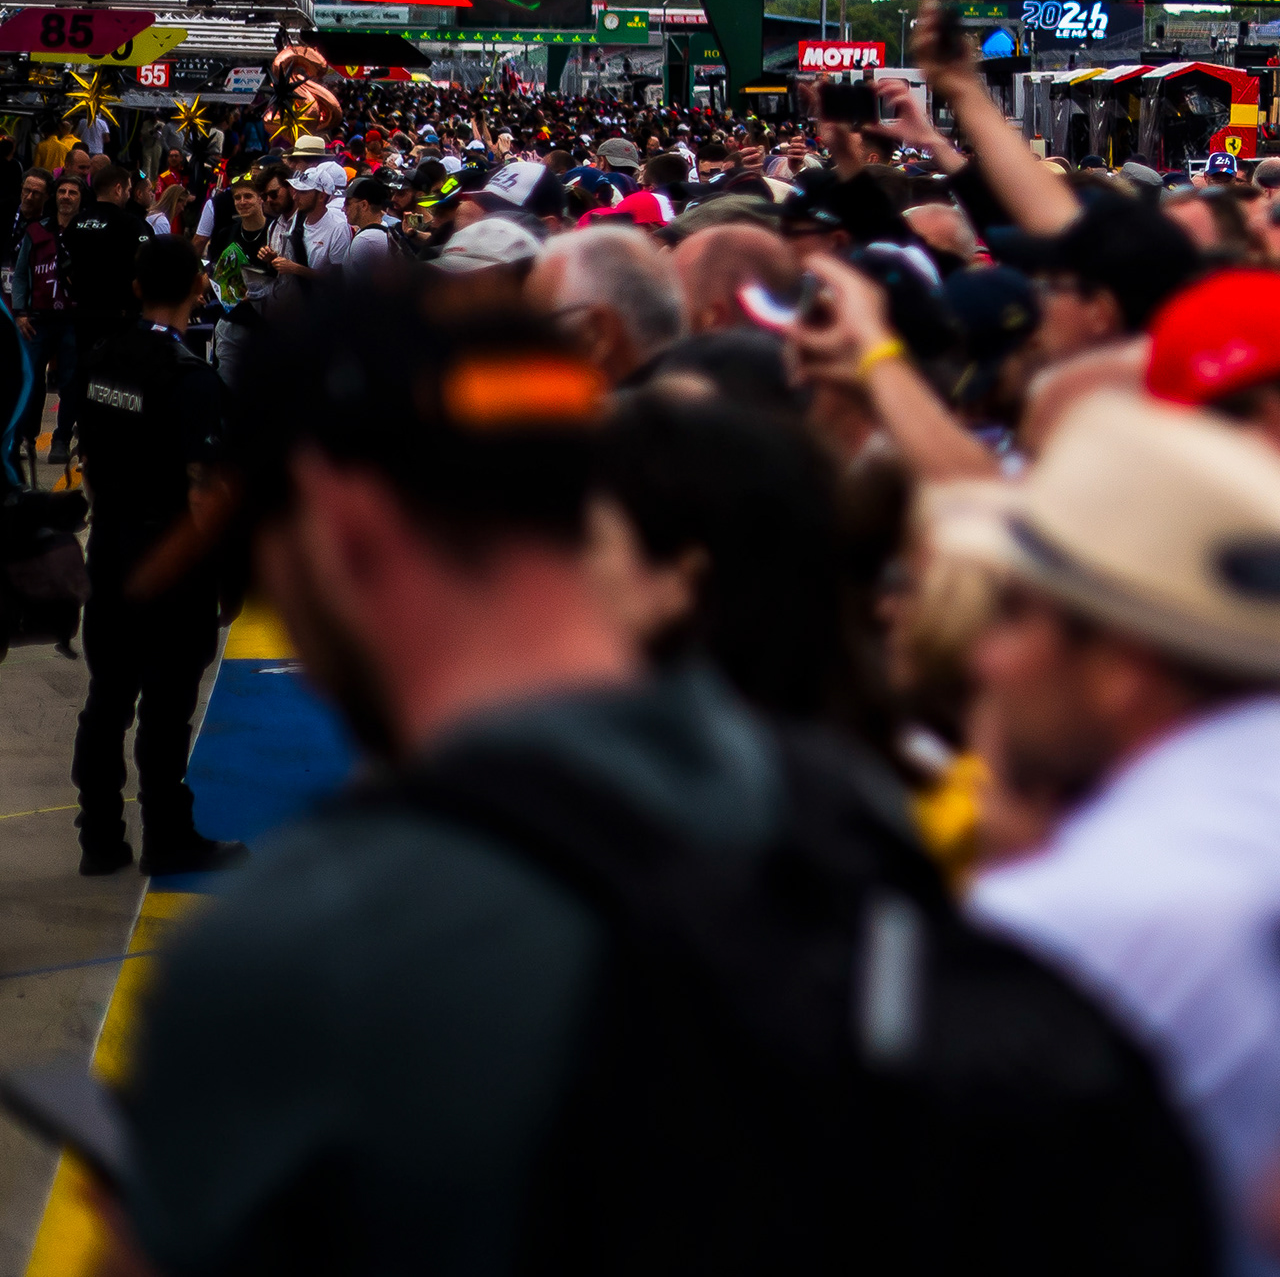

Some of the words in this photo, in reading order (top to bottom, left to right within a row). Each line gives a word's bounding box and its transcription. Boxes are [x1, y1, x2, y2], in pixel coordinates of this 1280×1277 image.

[39, 12, 96, 49] 85
[801, 46, 880, 67] MOTUL
[139, 64, 166, 86] 55
[86, 382, 143, 413] INTERVENTION
